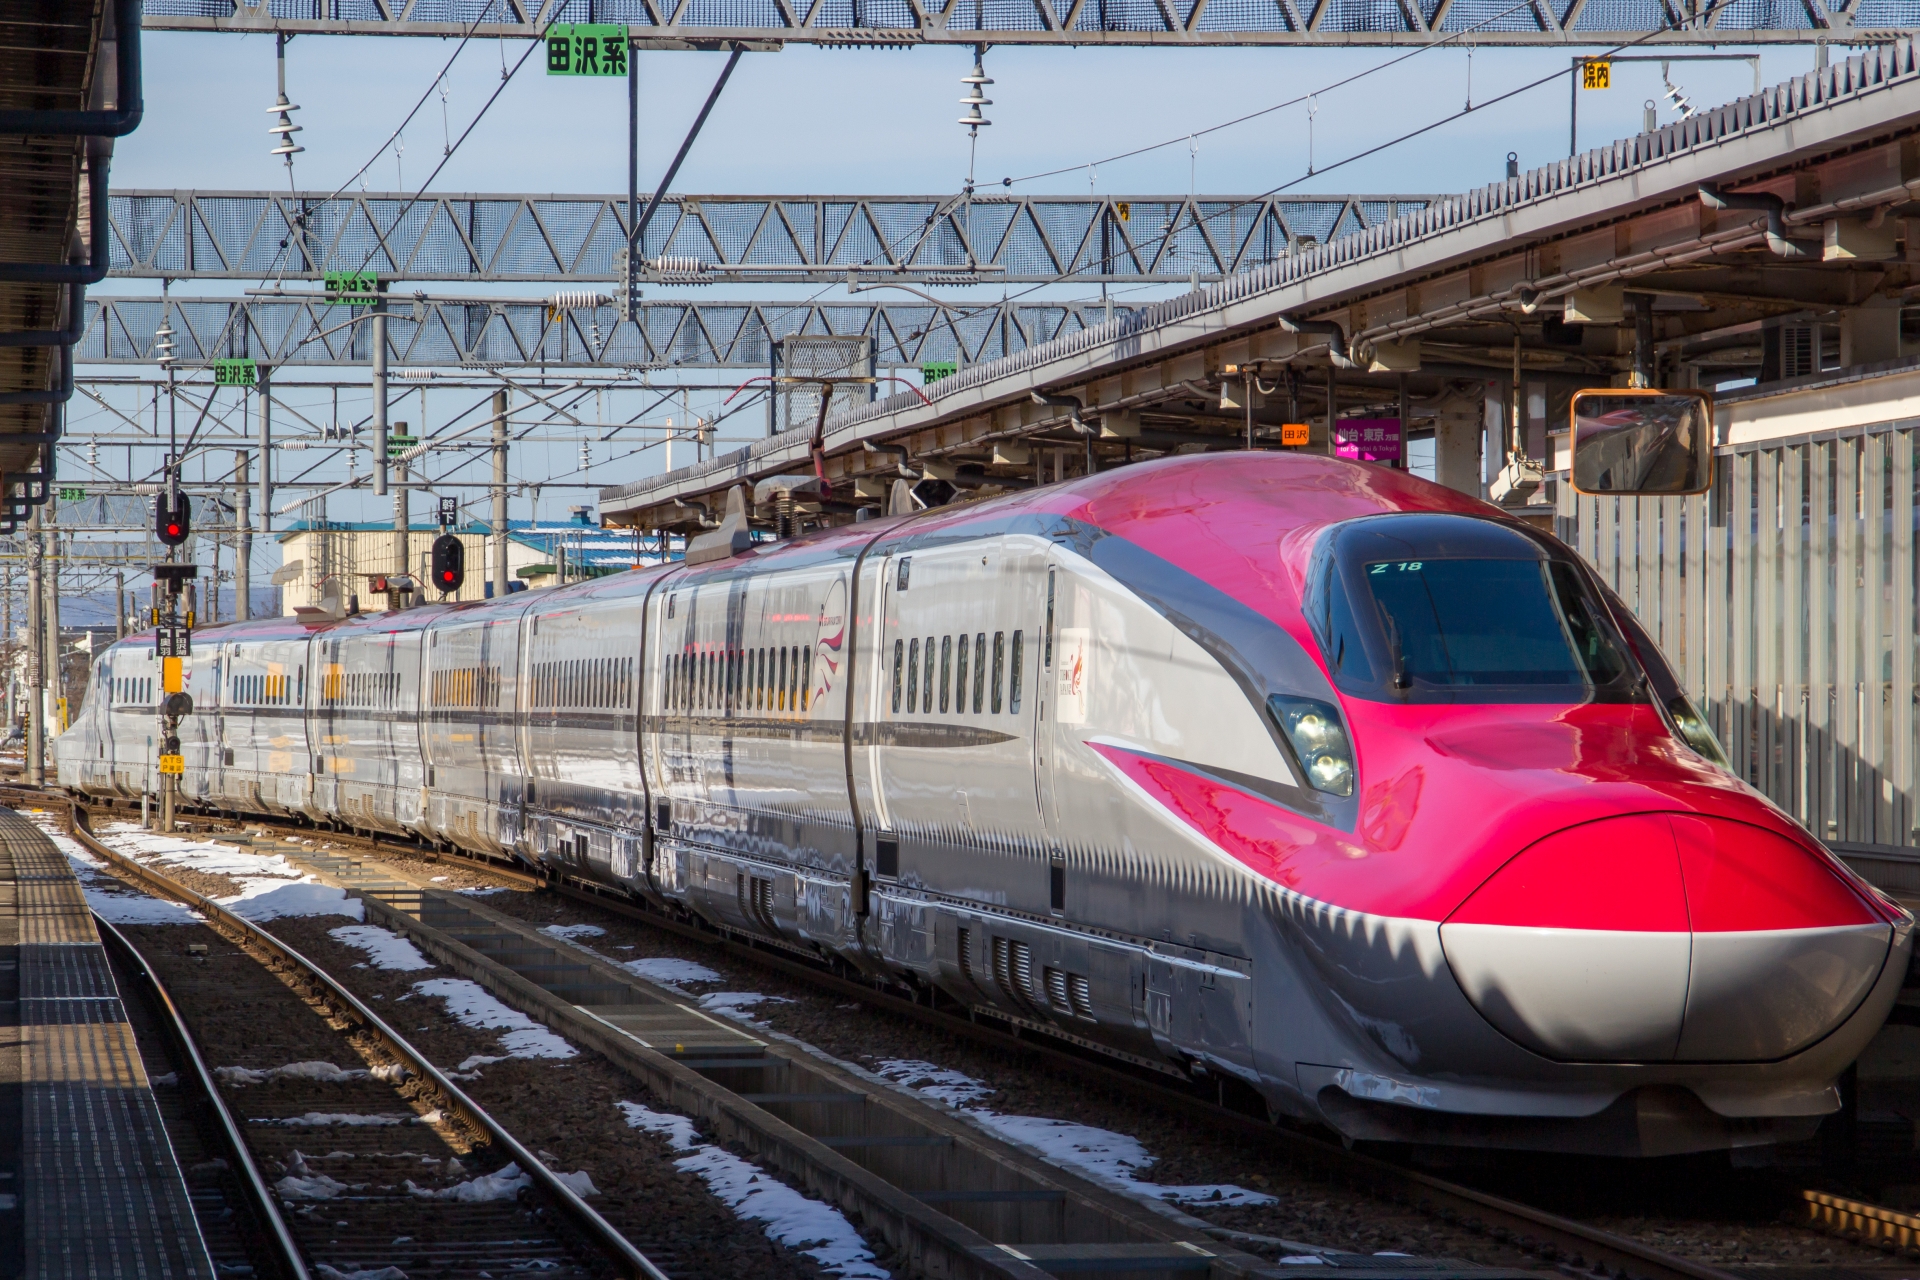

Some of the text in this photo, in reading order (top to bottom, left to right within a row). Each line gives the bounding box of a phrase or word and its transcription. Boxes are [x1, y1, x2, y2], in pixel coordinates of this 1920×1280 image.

[548, 36, 626, 74] 田沢系
[215, 365, 254, 383] 田沢系
[1284, 430, 1307, 439] 田沢
[1350, 444, 1371, 452] Sendai
[60, 488, 85, 500] 田沢系
[442, 499, 454, 524] 幹下
[1371, 562, 1422, 574] Z 18
[160, 638, 171, 656] 奥羽
[176, 638, 187, 656] 田沢湖
